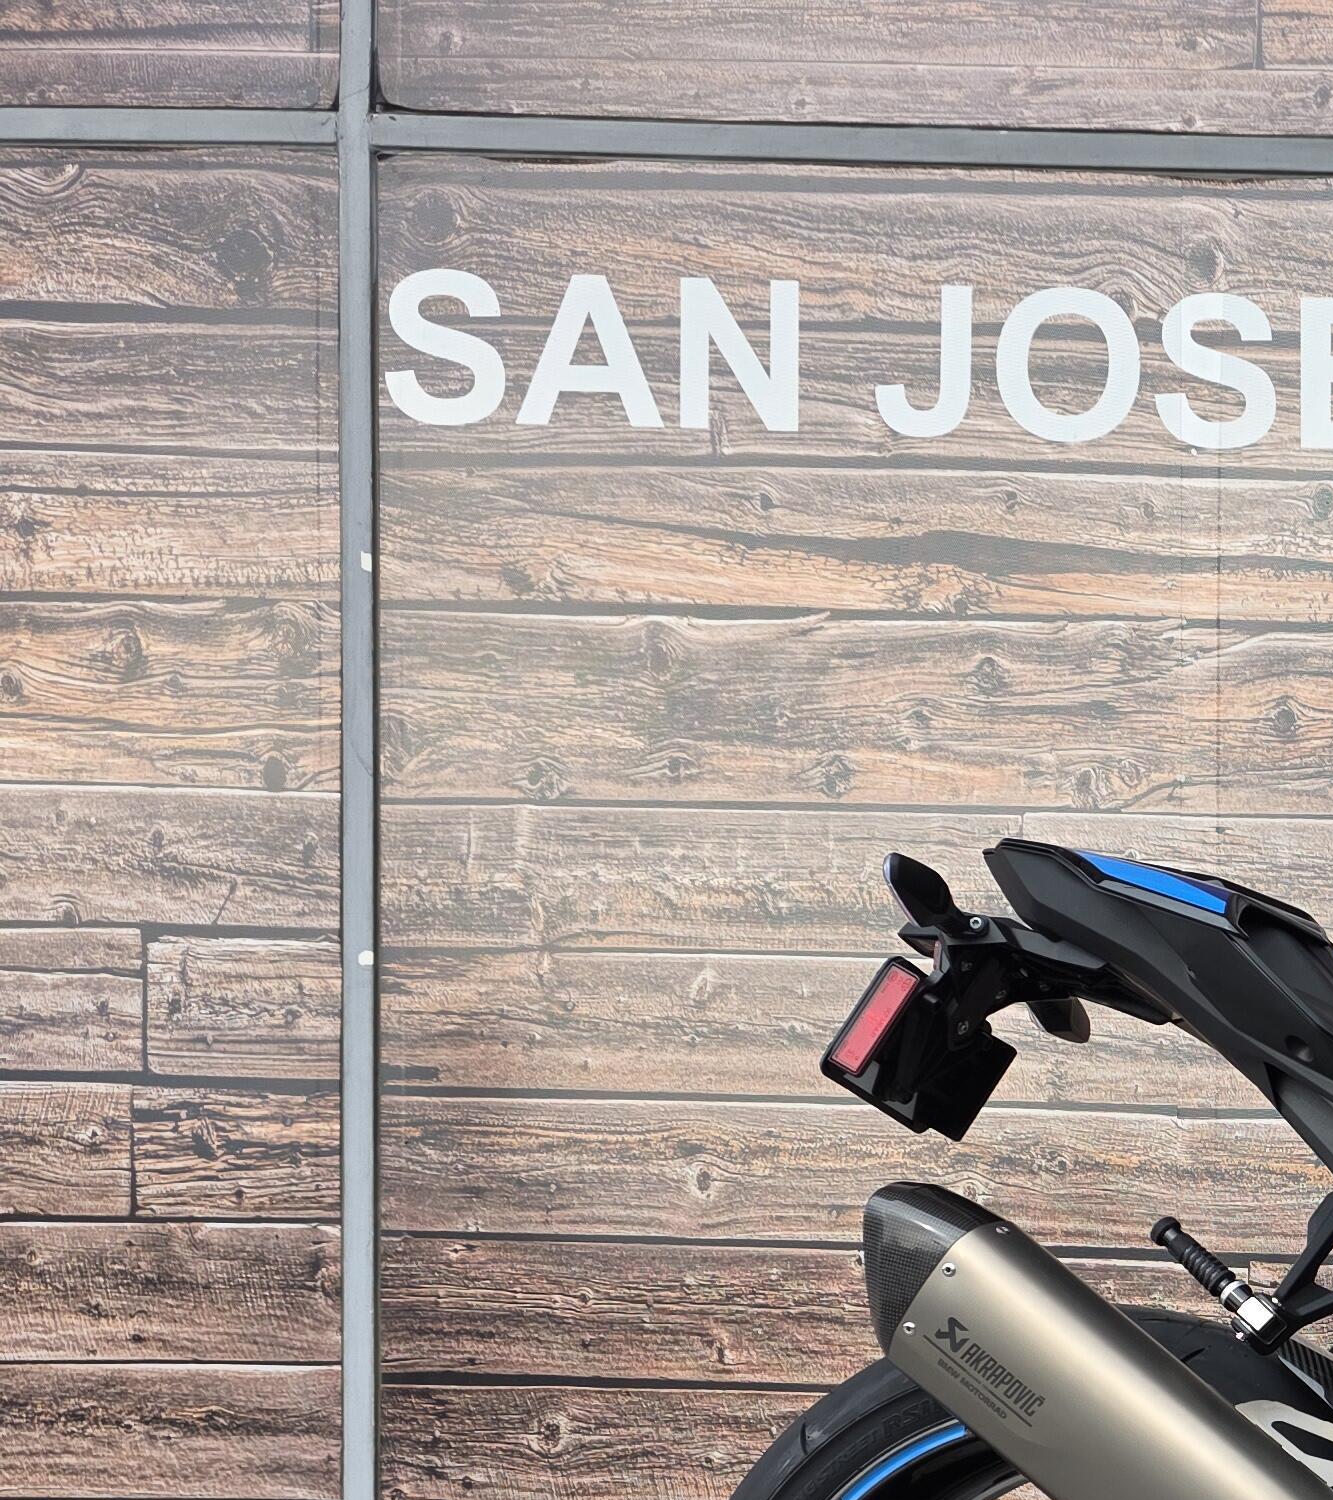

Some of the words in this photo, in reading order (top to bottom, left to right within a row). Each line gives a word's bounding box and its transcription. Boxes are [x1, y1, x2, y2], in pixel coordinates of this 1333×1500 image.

[382, 266, 802, 433] SAN
[937, 1358, 959, 1380] BMW
[959, 1377, 1008, 1420] MOTORRAD
